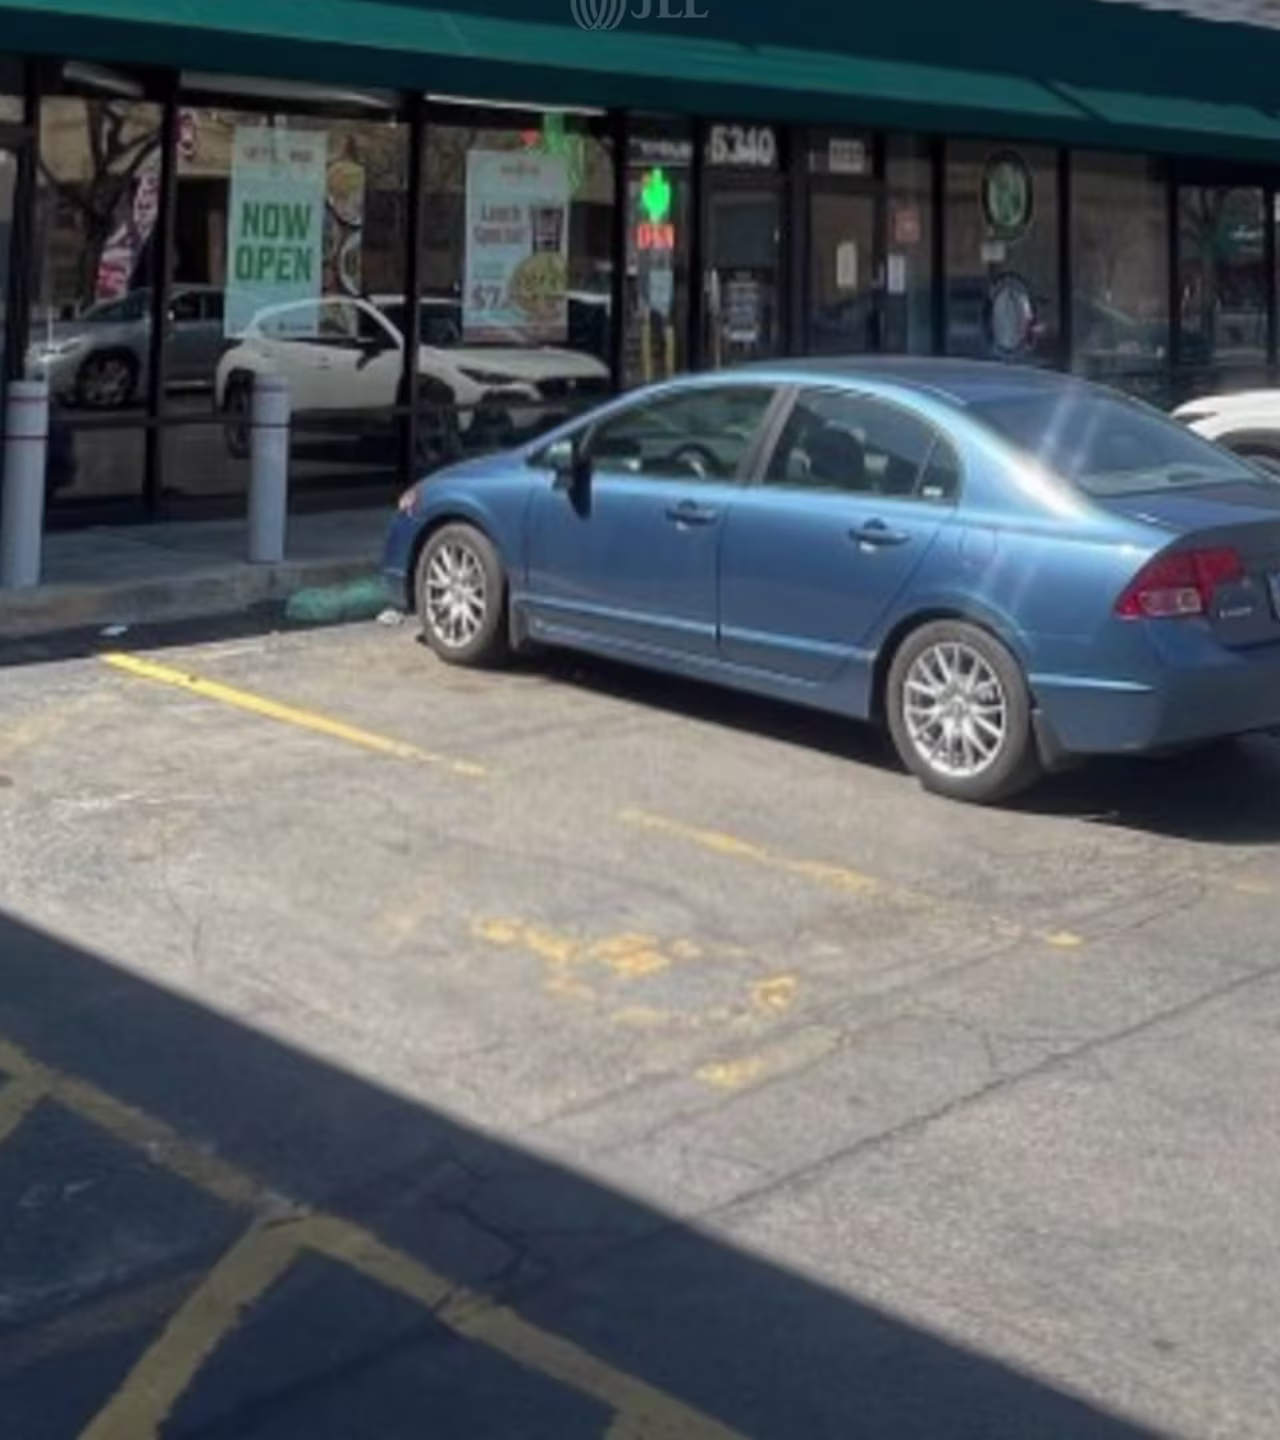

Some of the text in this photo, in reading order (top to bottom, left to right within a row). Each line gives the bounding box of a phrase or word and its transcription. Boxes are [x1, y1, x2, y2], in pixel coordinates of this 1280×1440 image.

[710, 125, 776, 166] 5340
[240, 201, 313, 242] NOW
[234, 243, 313, 283] OPEN
